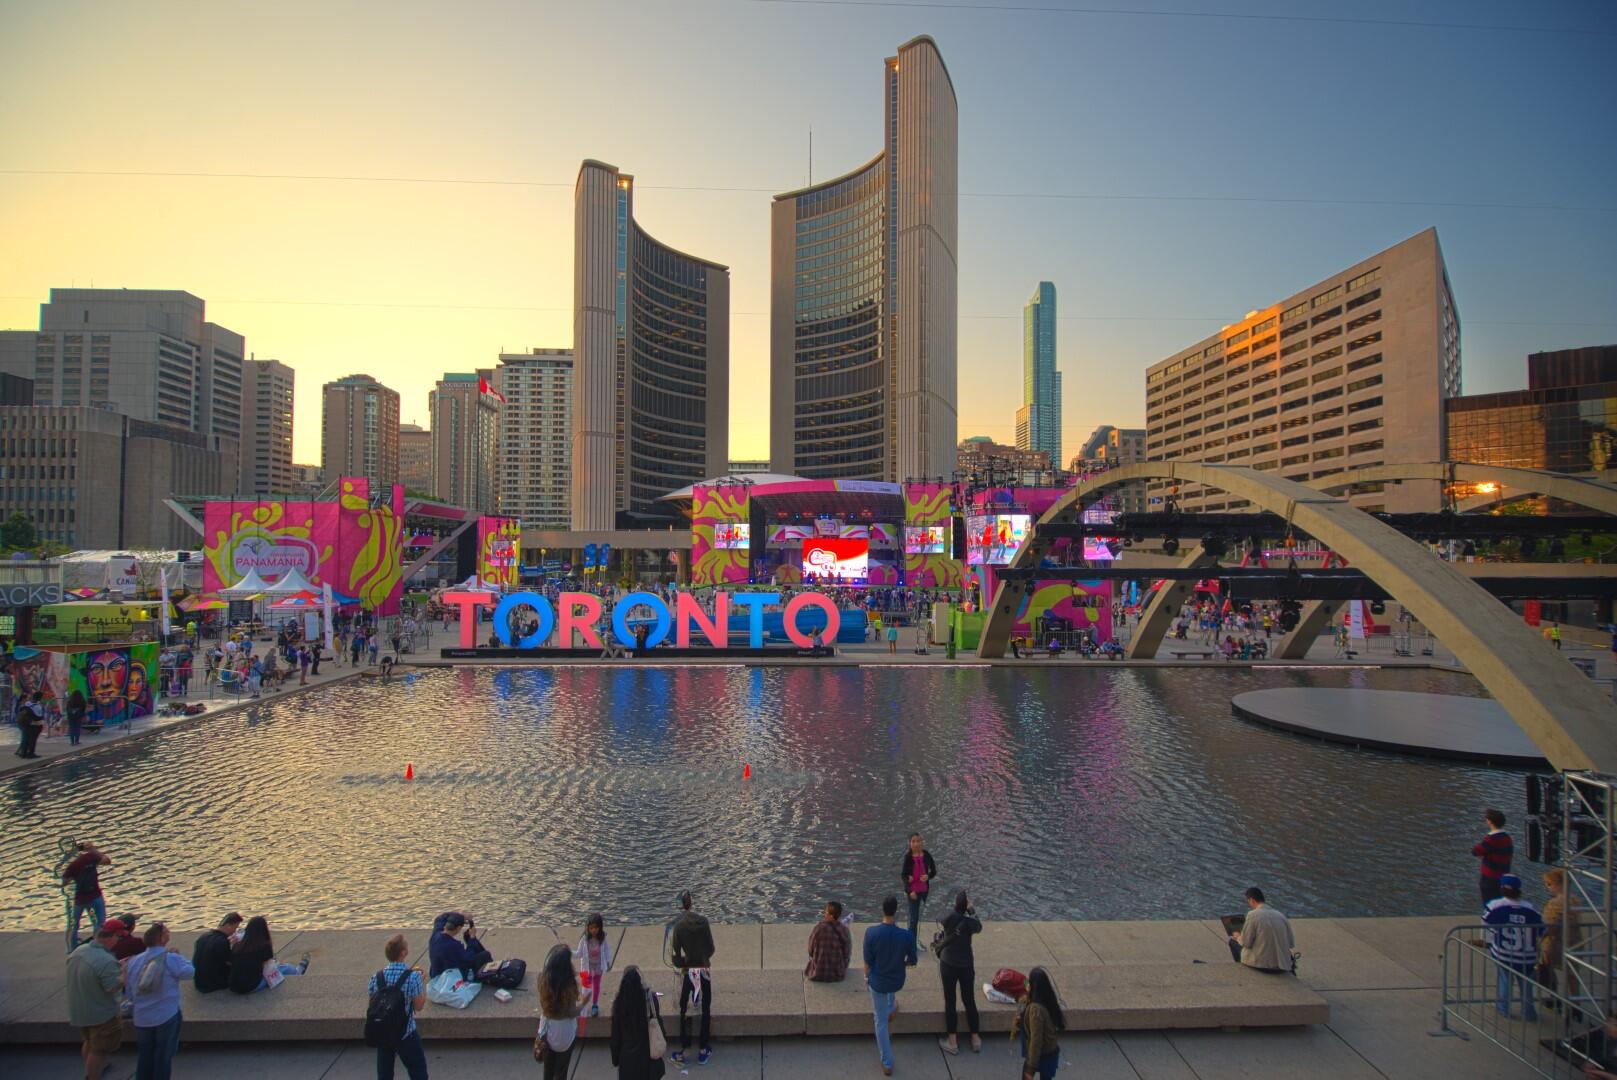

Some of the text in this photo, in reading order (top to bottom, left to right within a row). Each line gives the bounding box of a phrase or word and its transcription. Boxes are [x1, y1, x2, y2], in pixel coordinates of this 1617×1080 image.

[235, 558, 305, 567] PANAMANIA
[76, 616, 133, 626] LOCALISTA
[443, 591, 841, 649] TORONTO
[1502, 926, 1535, 952] 91
